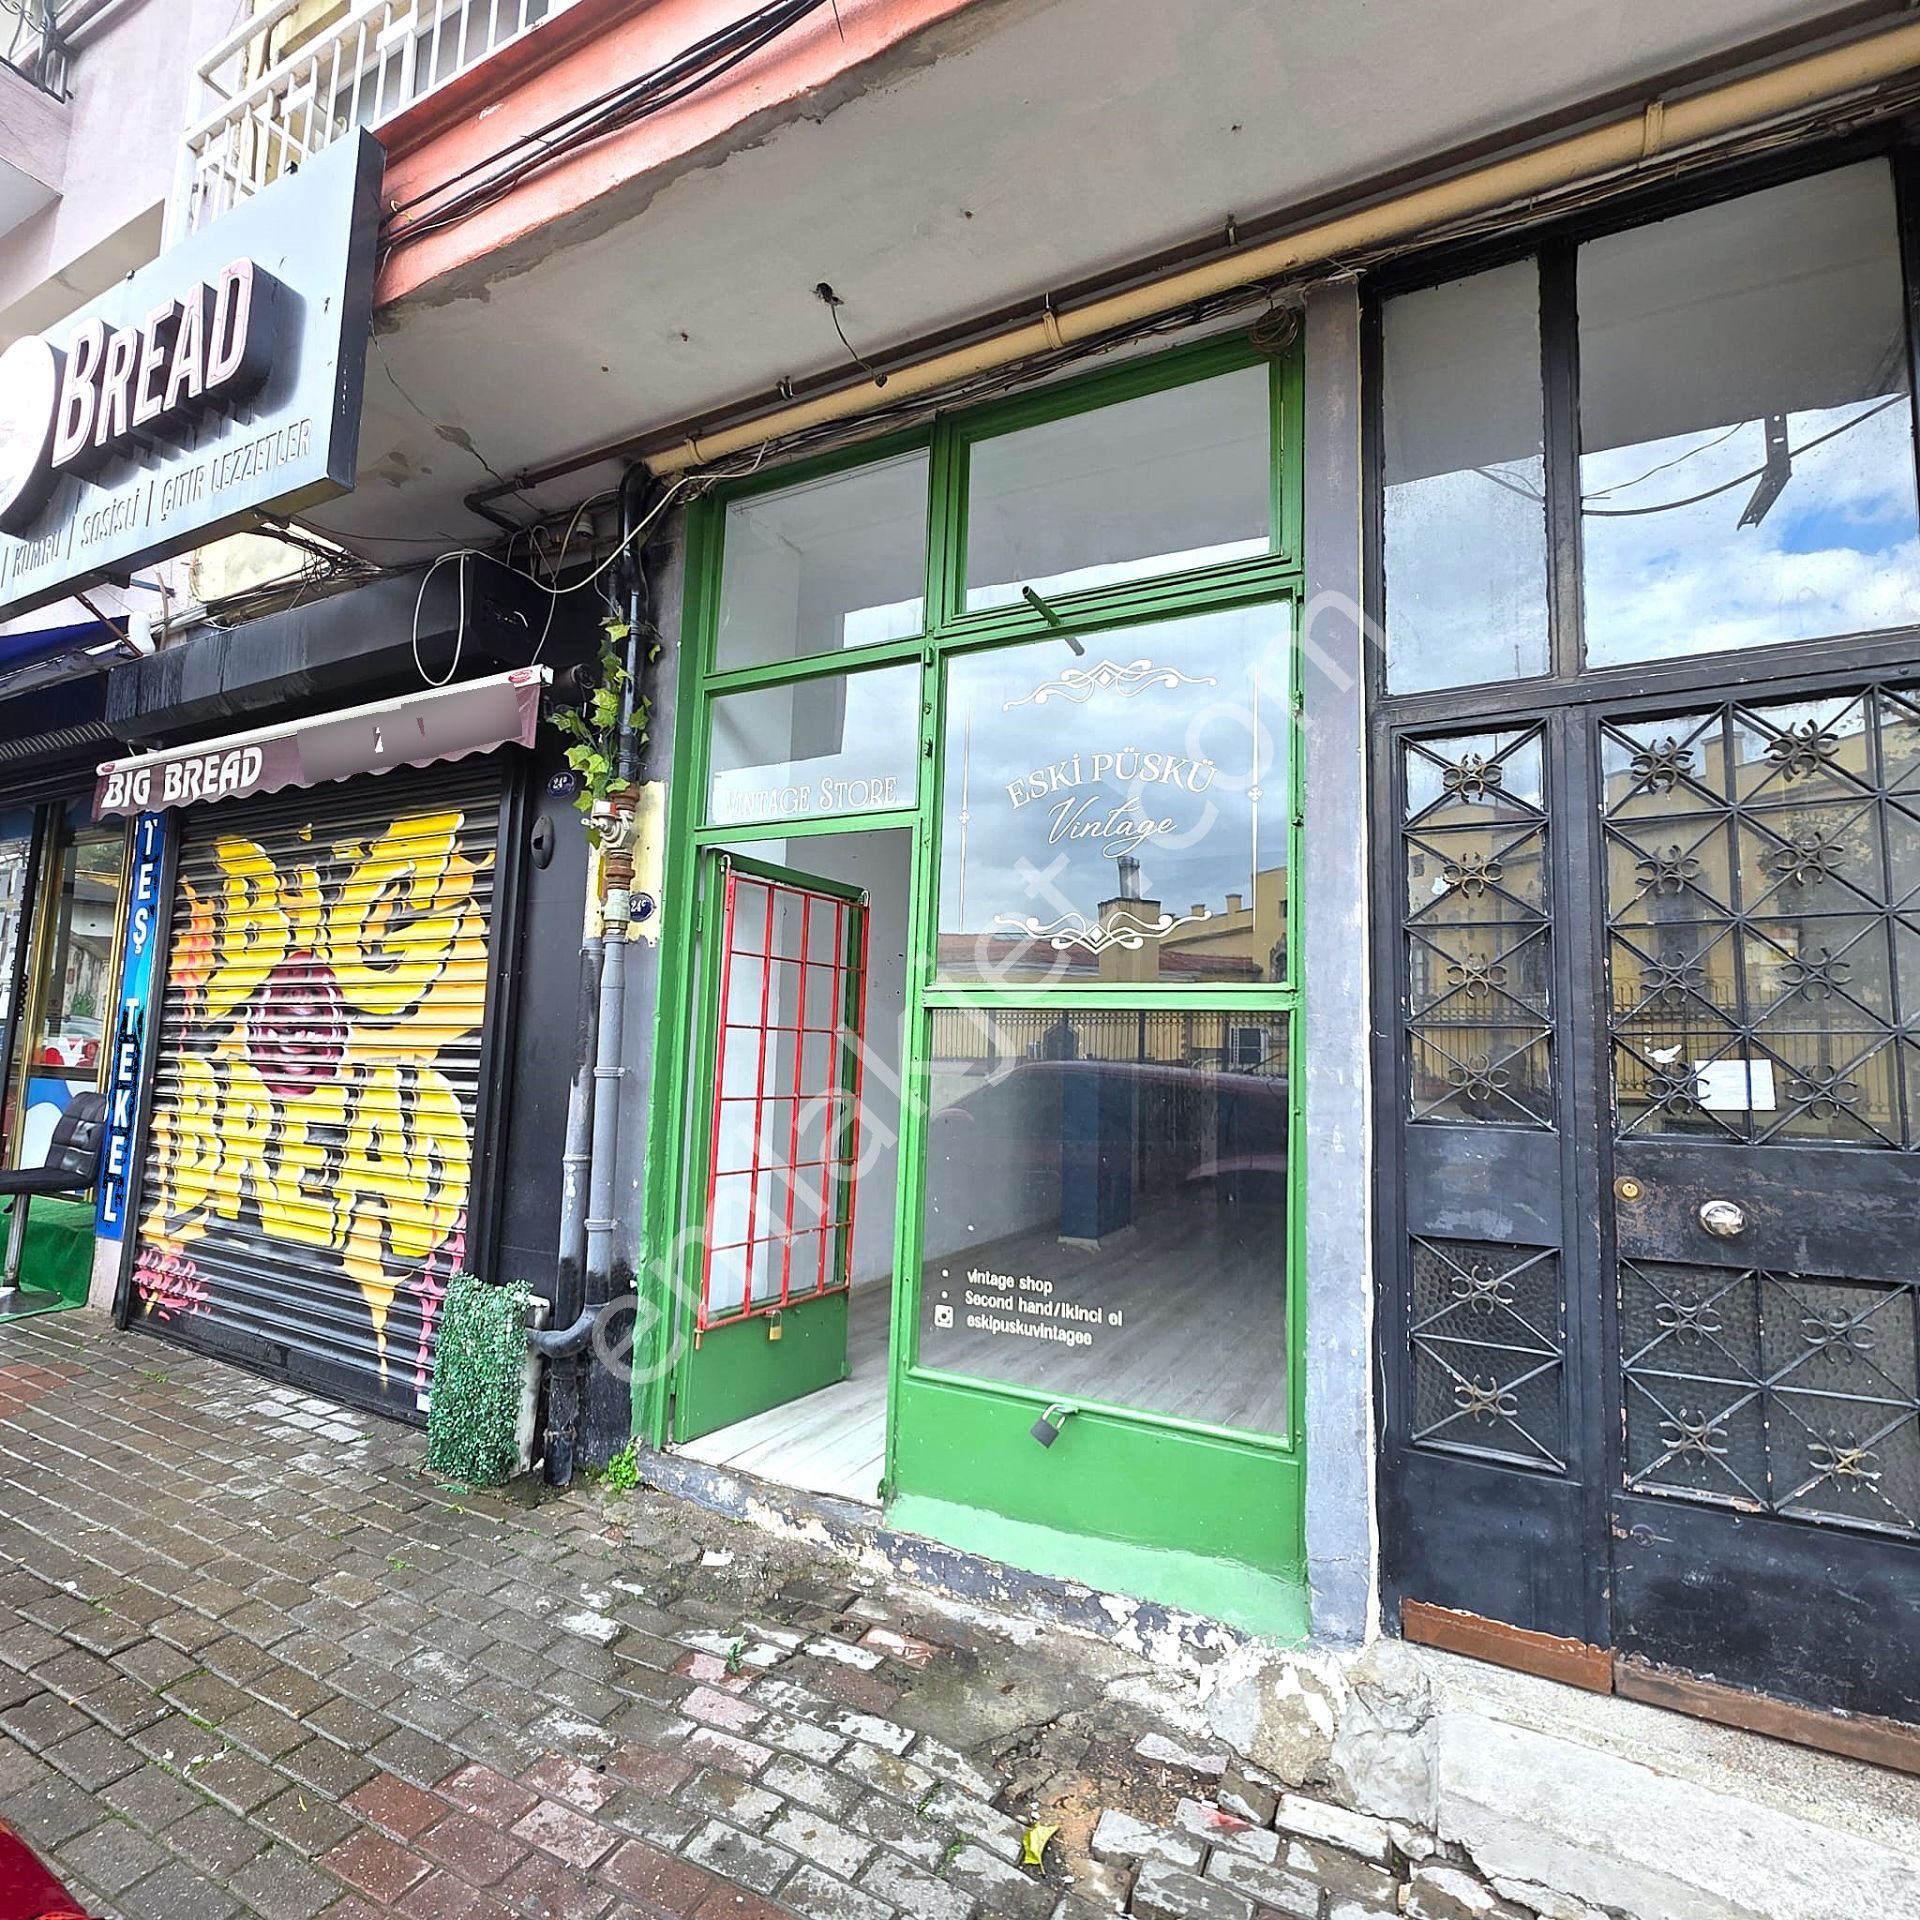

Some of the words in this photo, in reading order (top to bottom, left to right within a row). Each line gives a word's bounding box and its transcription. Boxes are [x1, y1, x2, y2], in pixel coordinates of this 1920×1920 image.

[52, 256, 254, 468] BREAD
[12, 527, 62, 577] KUMRU
[81, 487, 140, 549] SOSİSLİ
[161, 465, 205, 521] ÇITIR
[211, 418, 313, 493] LEZZETLER
[101, 768, 151, 809] BIG
[162, 746, 263, 802] BREAD
[725, 785, 811, 819] VINTAGE
[1005, 753, 1083, 810] ESKİ
[1092, 746, 1219, 793] PÜSKÜ
[1048, 795, 1179, 859] Vintage
[132, 808, 159, 955] TEŞ
[103, 997, 140, 1223] TEKEL
[964, 1289, 1014, 1311] Second
[1107, 1309, 1124, 1327] el
[966, 1267, 1015, 1291] vintage
[1018, 1275, 1054, 1297] shop
